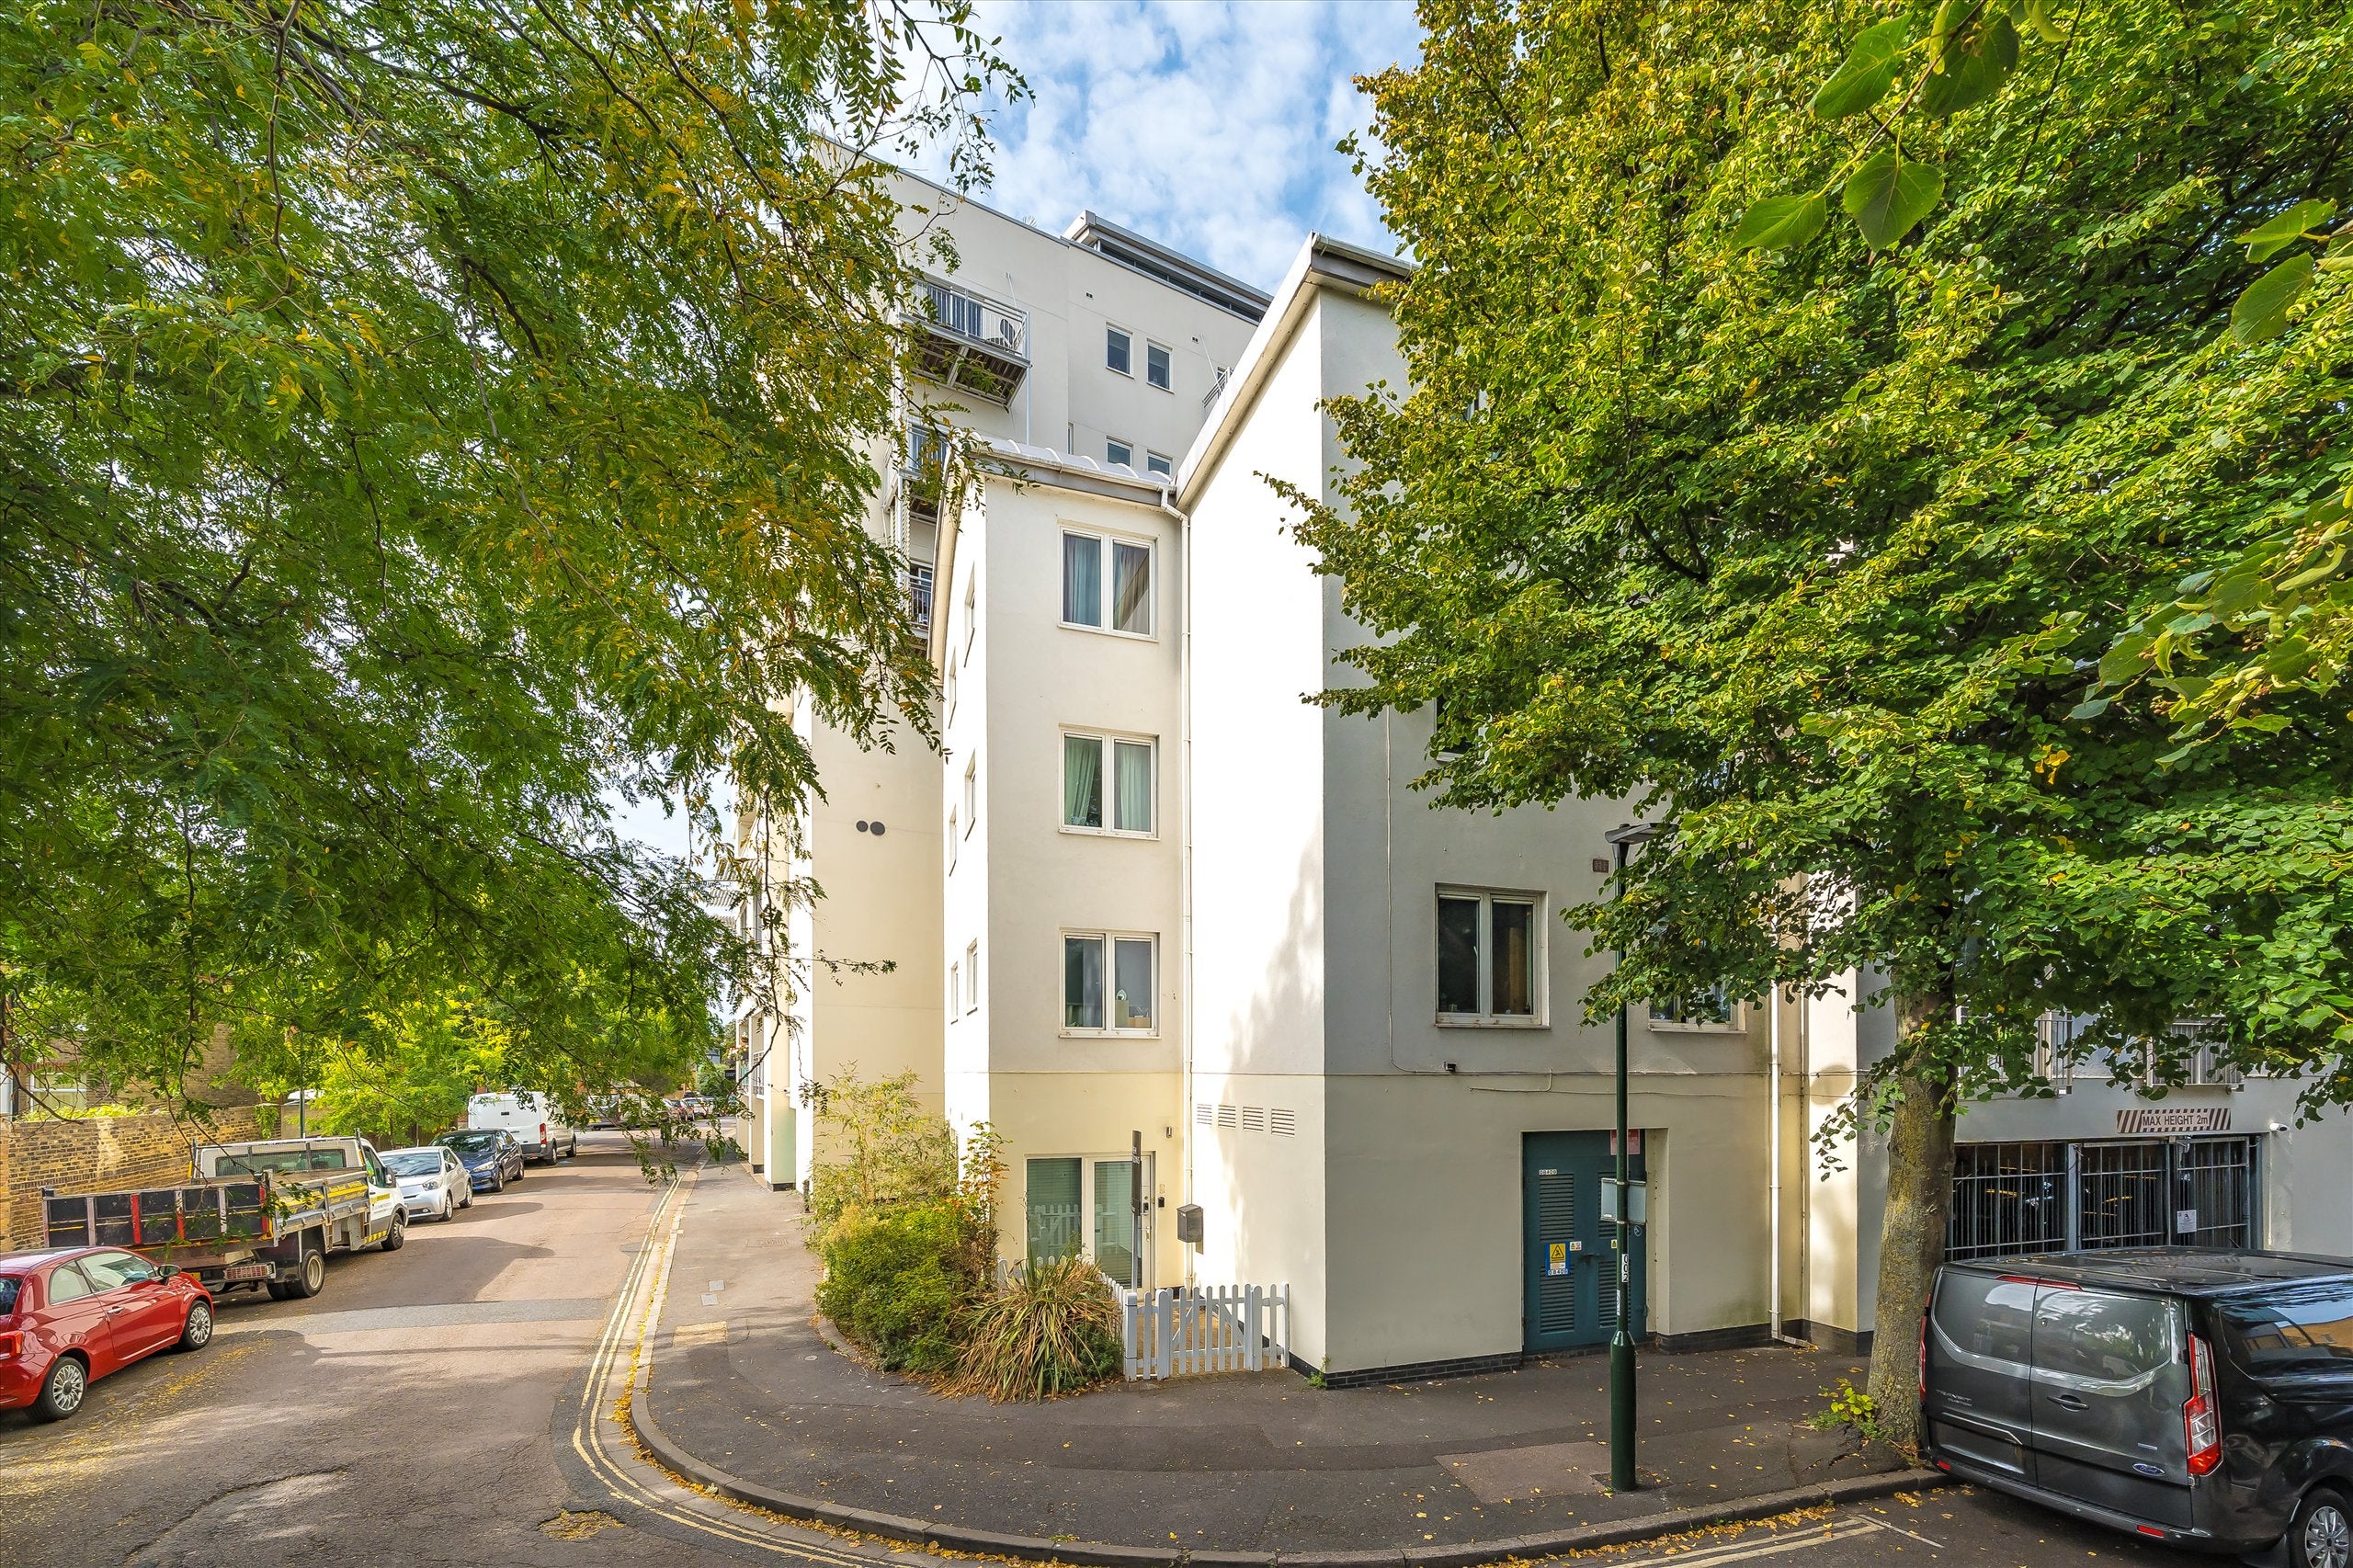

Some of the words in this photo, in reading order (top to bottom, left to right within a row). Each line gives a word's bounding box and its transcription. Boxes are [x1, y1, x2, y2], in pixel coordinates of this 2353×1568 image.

[2143, 1116, 2161, 1126] MAX
[2165, 1115, 2194, 1125] HEIGHT
[2197, 1115, 2208, 1125] 2m
